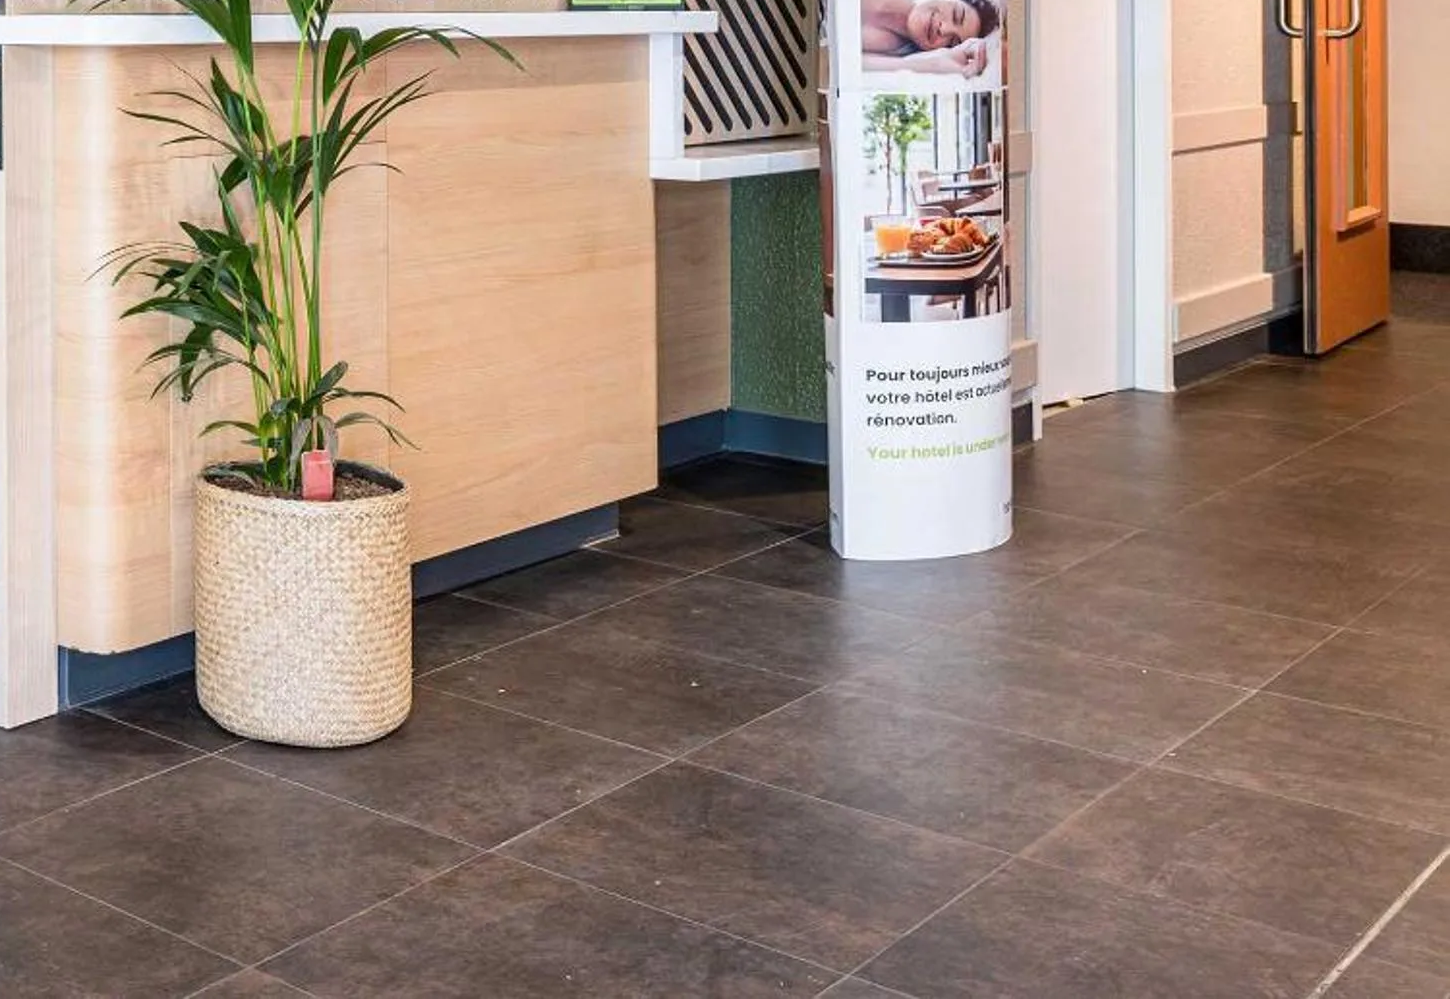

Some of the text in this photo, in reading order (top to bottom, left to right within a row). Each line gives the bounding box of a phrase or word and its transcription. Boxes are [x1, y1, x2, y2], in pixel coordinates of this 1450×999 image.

[866, 369, 905, 382] Pour
[910, 366, 969, 384] toujours
[866, 392, 910, 405] votre
[915, 388, 952, 403] hôtel
[955, 389, 974, 401] est
[866, 412, 957, 428] rénovation.
[868, 446, 907, 459] Your
[912, 444, 950, 458] hotel
